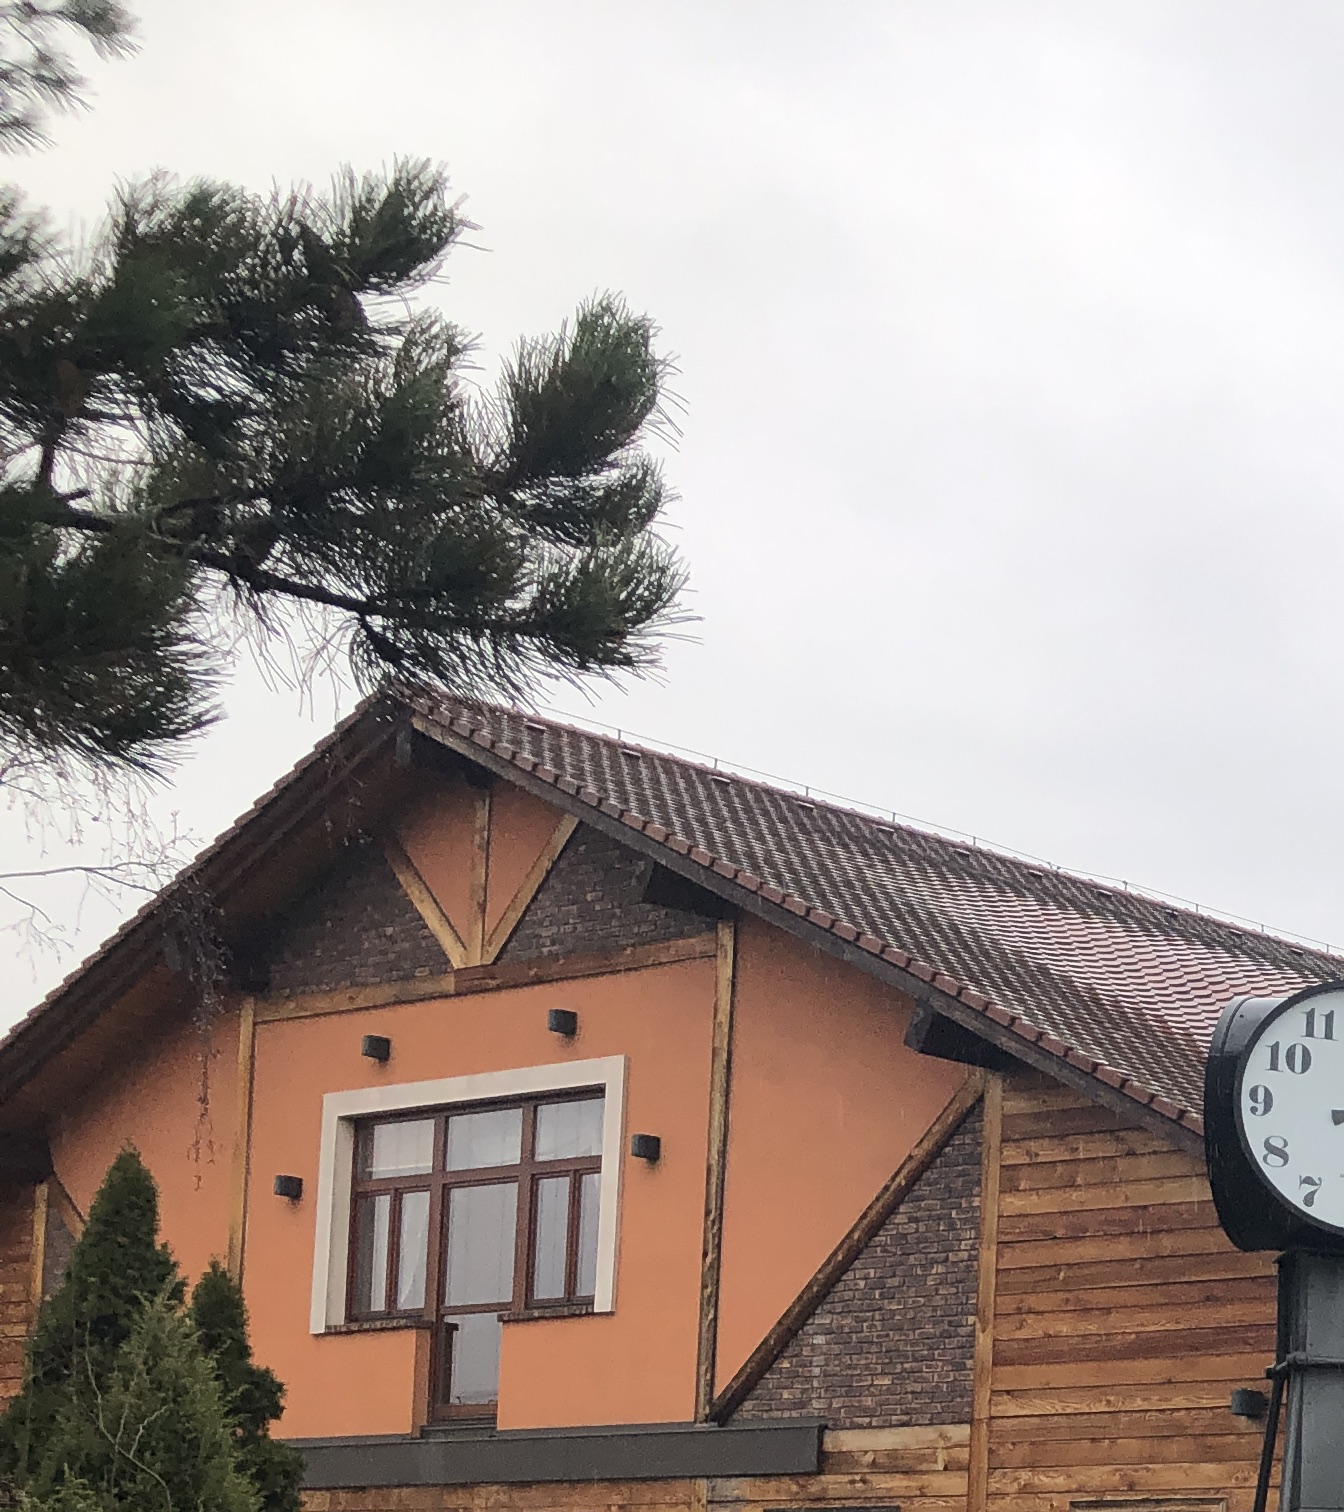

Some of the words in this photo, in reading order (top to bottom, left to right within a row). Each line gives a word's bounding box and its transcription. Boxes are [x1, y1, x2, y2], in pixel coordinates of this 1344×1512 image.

[1301, 1008, 1338, 1041] 11
[1265, 1040, 1312, 1075] 10
[1249, 1084, 1274, 1116] 9
[1262, 1135, 1290, 1168] 8
[1299, 1174, 1323, 1207] 7
